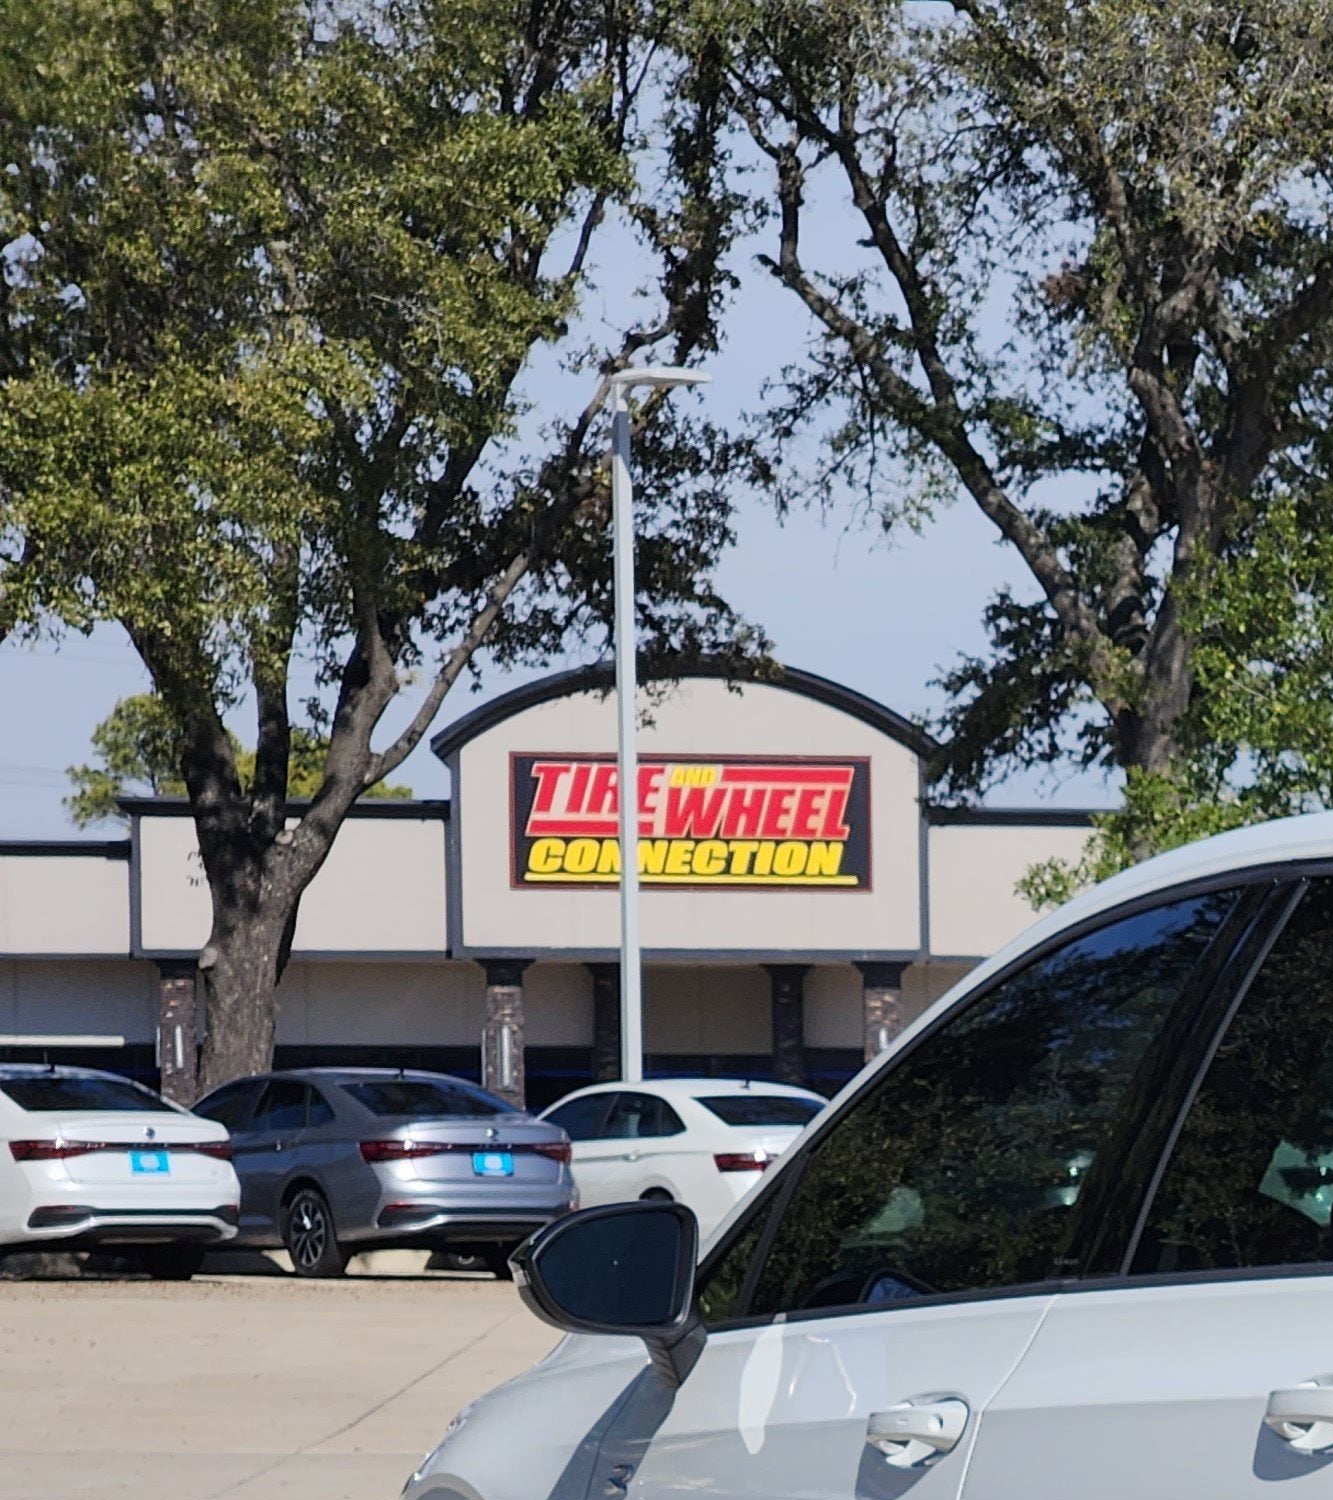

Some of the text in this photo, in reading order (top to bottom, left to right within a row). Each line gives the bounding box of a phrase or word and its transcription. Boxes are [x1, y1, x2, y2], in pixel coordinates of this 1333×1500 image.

[532, 763, 850, 839] TIRE AND WHEEL
[528, 837, 844, 877] CONNECTION
